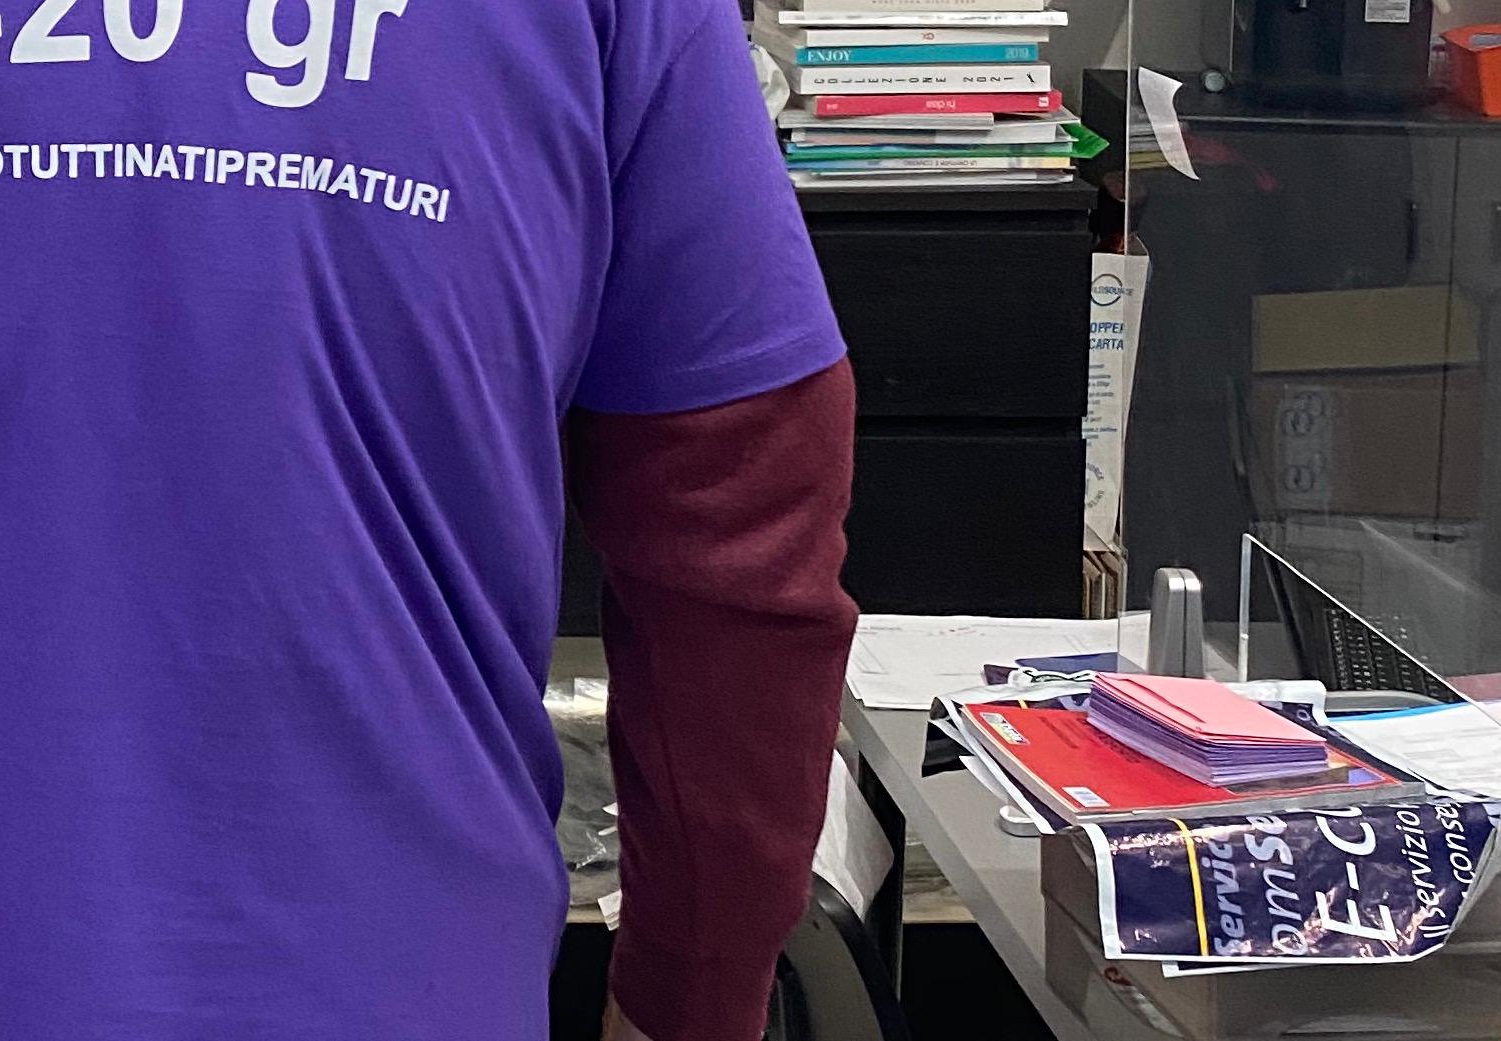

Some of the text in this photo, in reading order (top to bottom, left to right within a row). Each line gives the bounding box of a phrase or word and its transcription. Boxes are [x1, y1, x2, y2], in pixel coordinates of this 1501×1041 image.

[807, 48, 851, 62] ENJOY
[814, 75, 1015, 85] COLLEZIONE 2021
